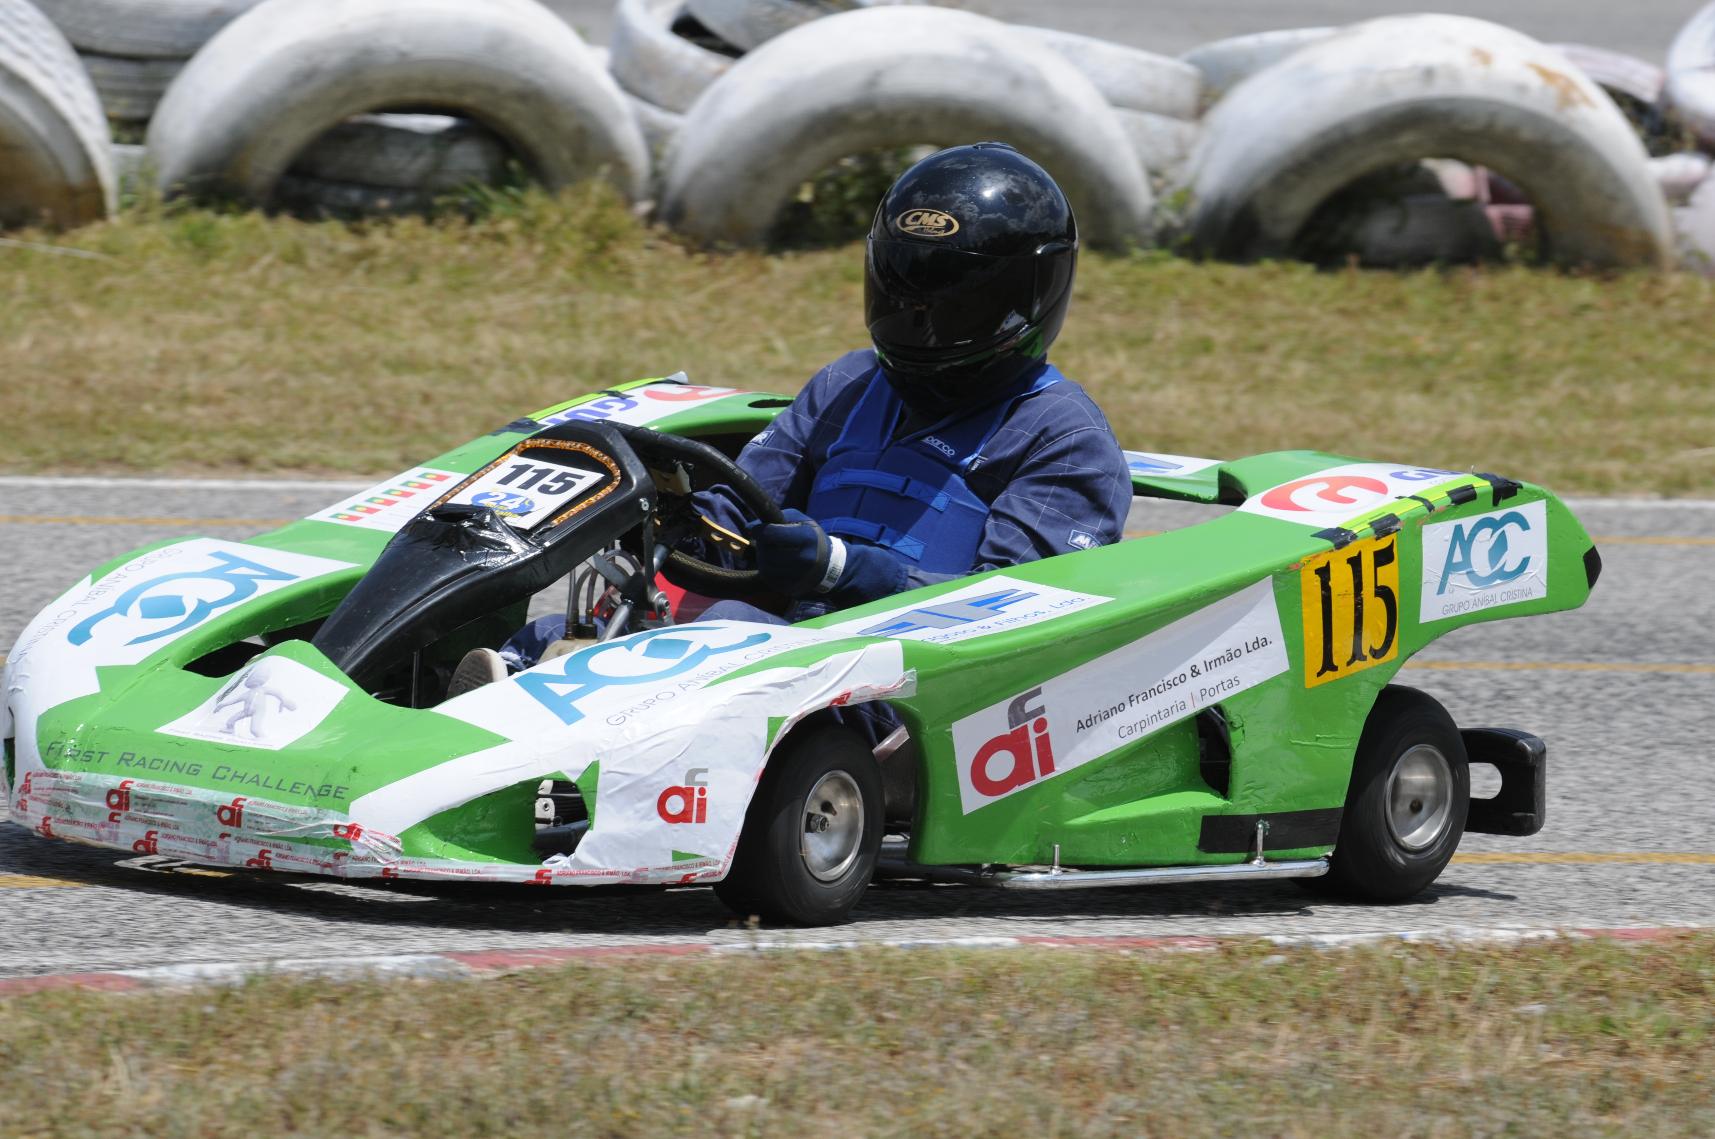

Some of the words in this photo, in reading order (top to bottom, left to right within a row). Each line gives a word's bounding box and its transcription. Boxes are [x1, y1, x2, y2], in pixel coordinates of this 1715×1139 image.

[904, 211, 950, 227] CMS
[922, 435, 956, 456] parco
[496, 463, 586, 496] 115
[1314, 538, 1398, 678] 115
[1442, 600, 1470, 616] GRUPO
[1500, 586, 1533, 602] CRISTINA
[1075, 702, 1126, 733] Adriano
[1127, 673, 1188, 708] Francisco
[1190, 663, 1202, 678] &
[1203, 647, 1243, 673] Irmão
[1245, 634, 1273, 654] Lda.
[606, 690, 676, 727] GRUPO
[1117, 698, 1187, 740] Carpintaria
[1199, 674, 1241, 702] Portas
[45, 740, 110, 765] FIRST
[116, 750, 203, 777] RACING
[211, 764, 350, 801] CHALLENGE
